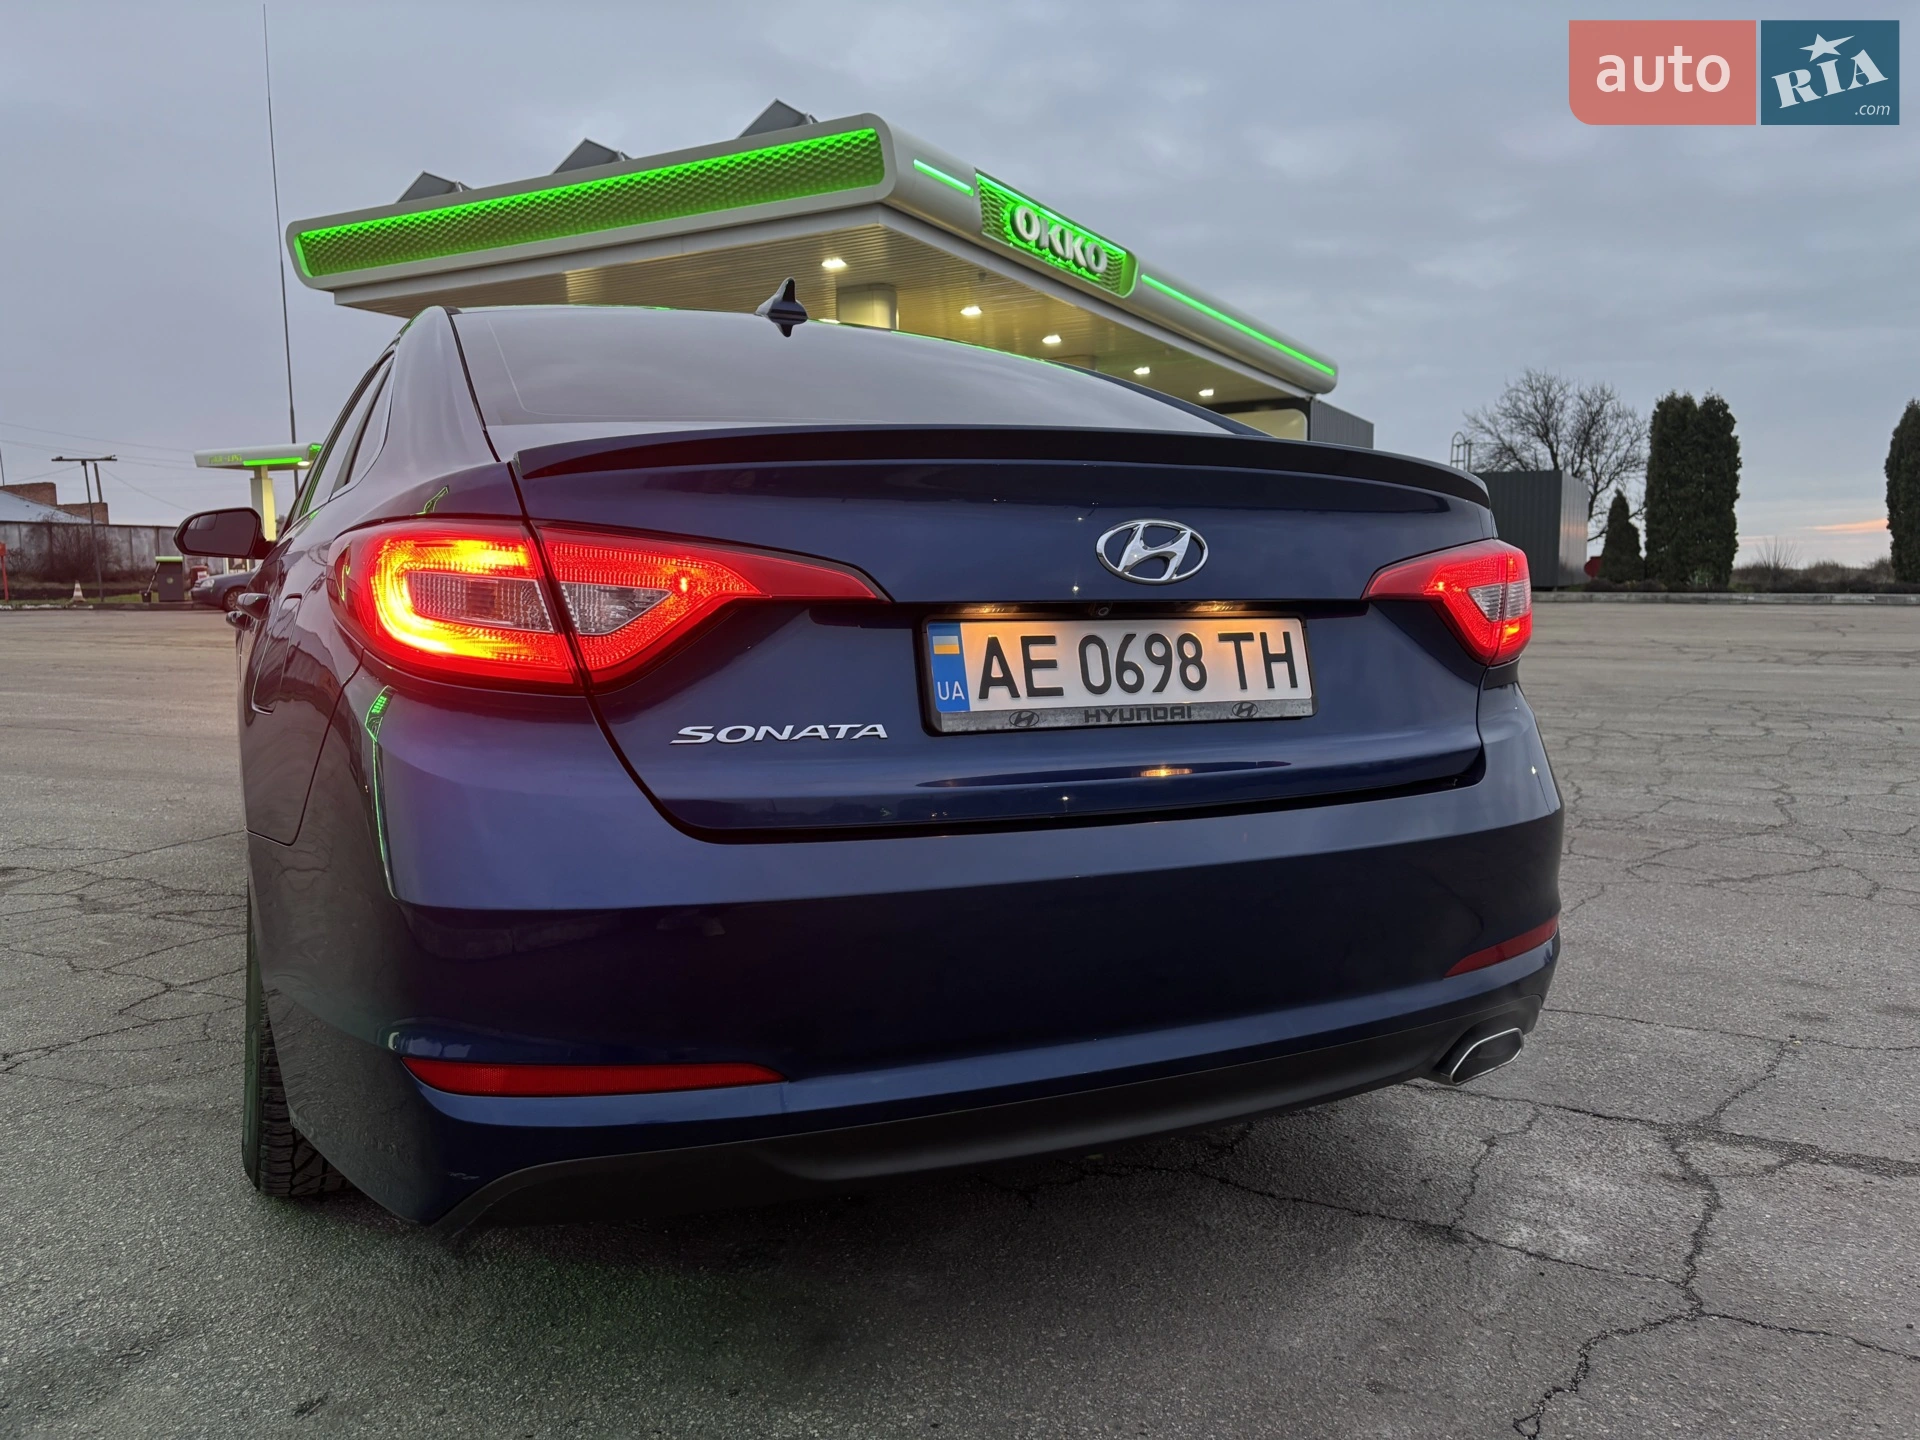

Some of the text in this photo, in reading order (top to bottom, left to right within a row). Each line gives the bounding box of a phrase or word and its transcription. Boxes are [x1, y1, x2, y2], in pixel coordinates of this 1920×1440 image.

[1012, 205, 1108, 274] OKKO
[978, 631, 1298, 699] AE 0698 TH
[938, 681, 965, 700] UA
[1084, 705, 1192, 723] HYUNDAI
[669, 723, 888, 744] SONATA
